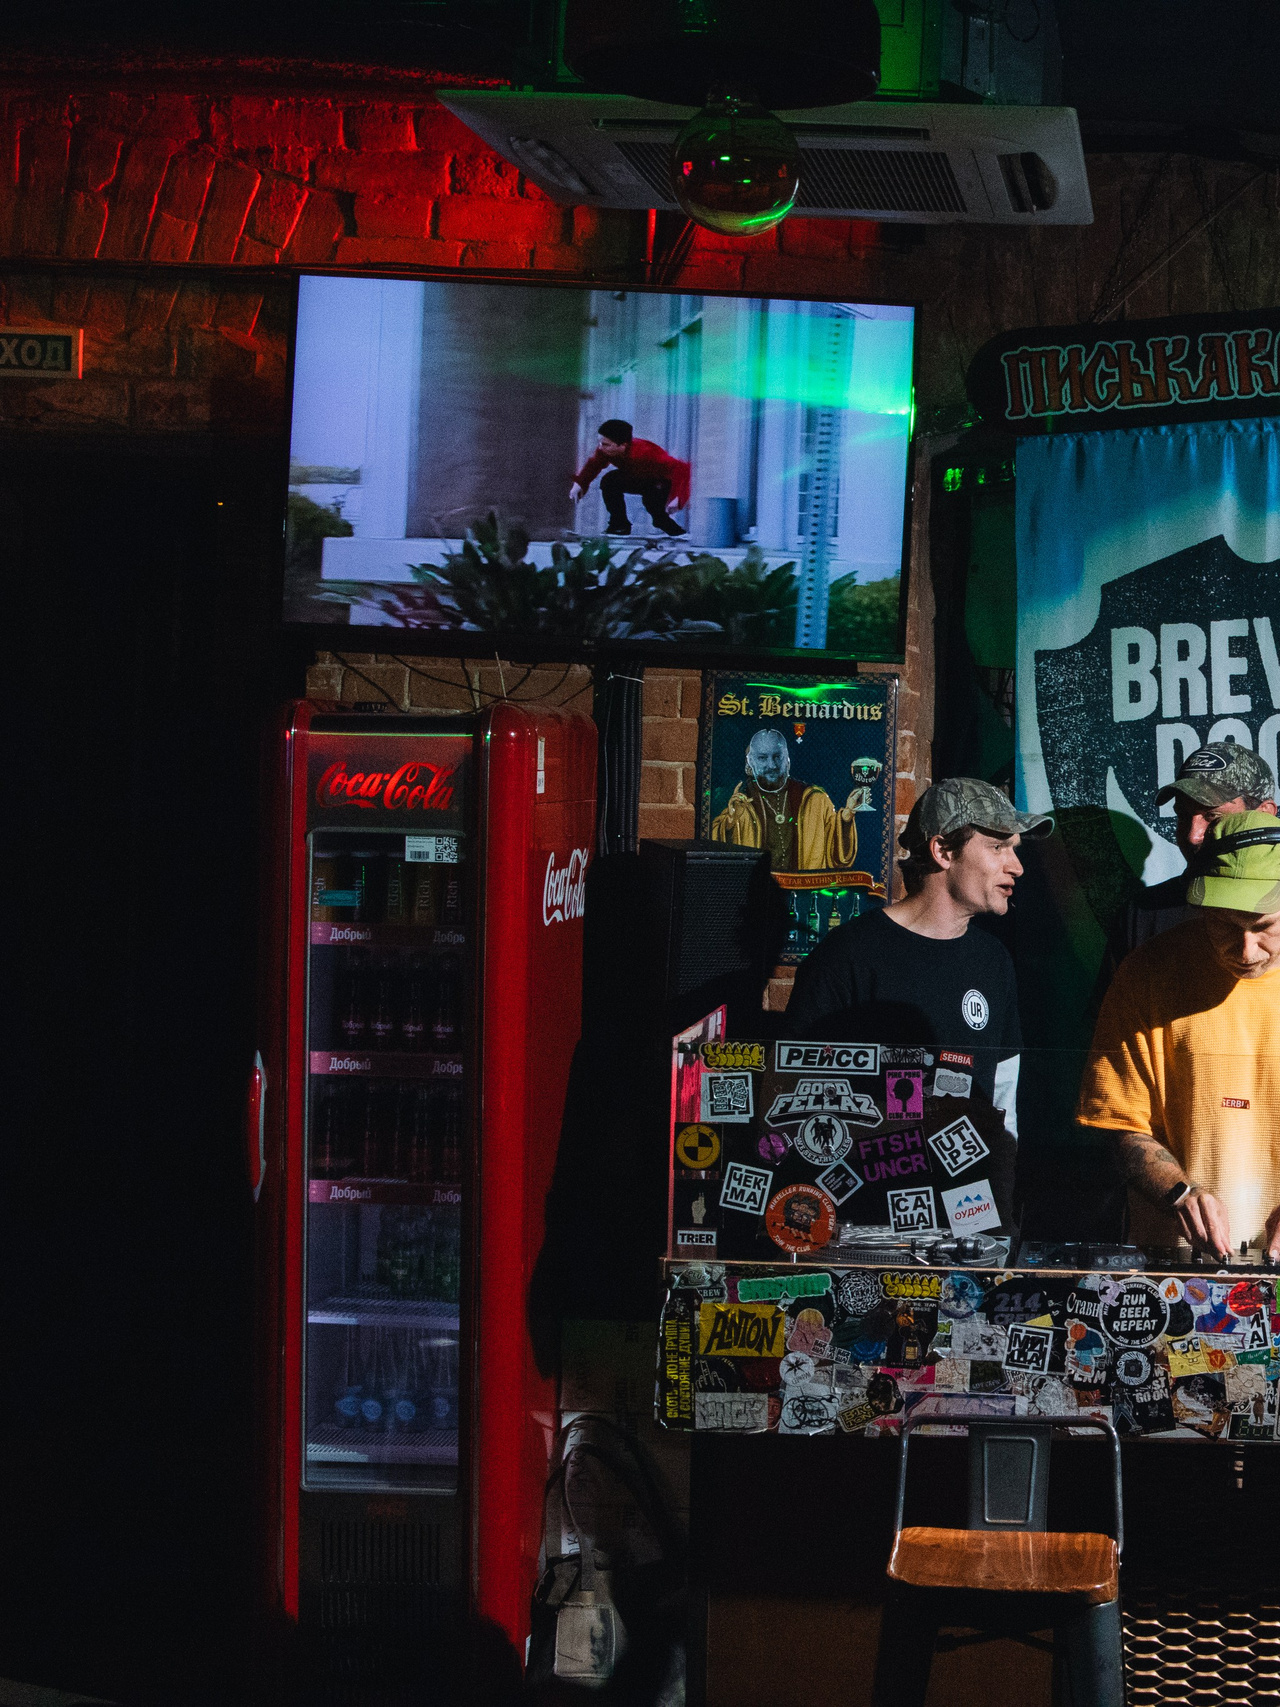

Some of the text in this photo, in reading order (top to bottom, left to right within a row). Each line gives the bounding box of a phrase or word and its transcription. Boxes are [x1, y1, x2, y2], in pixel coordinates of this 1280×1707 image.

[717, 692, 884, 722] St. Bernardus
[316, 761, 454, 811] Coca-Cola
[330, 927, 371, 942] Добрый
[971, 1001, 983, 1018] UR
[329, 1057, 371, 1072] Добрый
[941, 1052, 973, 1066] SERBIA
[432, 1060, 464, 1075] Добр
[857, 1129, 923, 1161] FTSH
[863, 1152, 929, 1183] UNCR
[330, 1185, 371, 1200] Добрый
[432, 1189, 462, 1203] Добр
[798, 1185, 823, 1199] RUNNING
[954, 1202, 991, 1221] ОУДЖИ
[993, 1292, 1042, 1313] 214
[1066, 1291, 1100, 1318] Ставн
[1122, 1293, 1147, 1306] RUN
[1119, 1306, 1151, 1319] BEER
[1112, 1319, 1159, 1332] REPEAT
[665, 1352, 678, 1363] НЕ
[679, 1356, 691, 1411] СОСТОЯНИЕ
